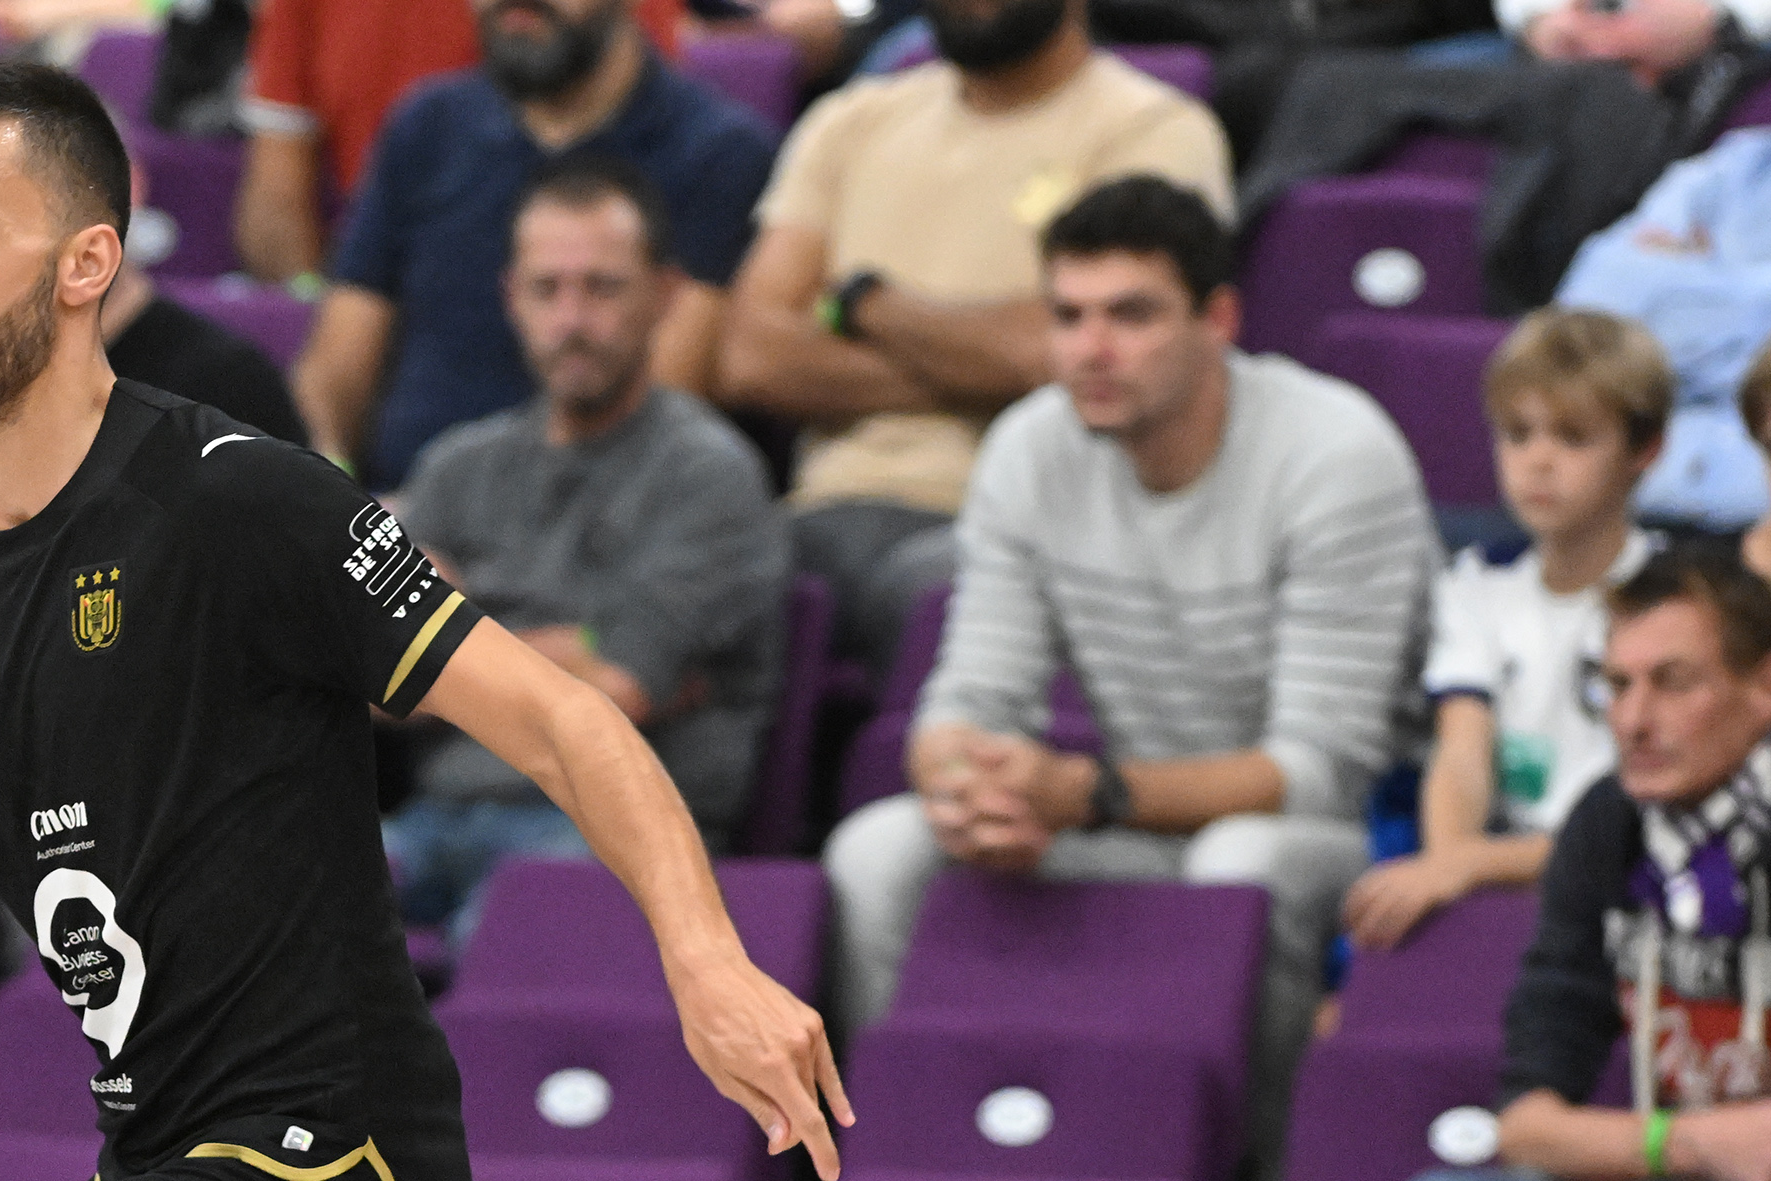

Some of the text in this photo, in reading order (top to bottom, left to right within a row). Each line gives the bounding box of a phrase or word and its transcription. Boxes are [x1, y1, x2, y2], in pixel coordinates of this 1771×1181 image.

[350, 555, 377, 582] DE
[391, 567, 438, 619] VOLV
[30, 801, 89, 842] Cnon
